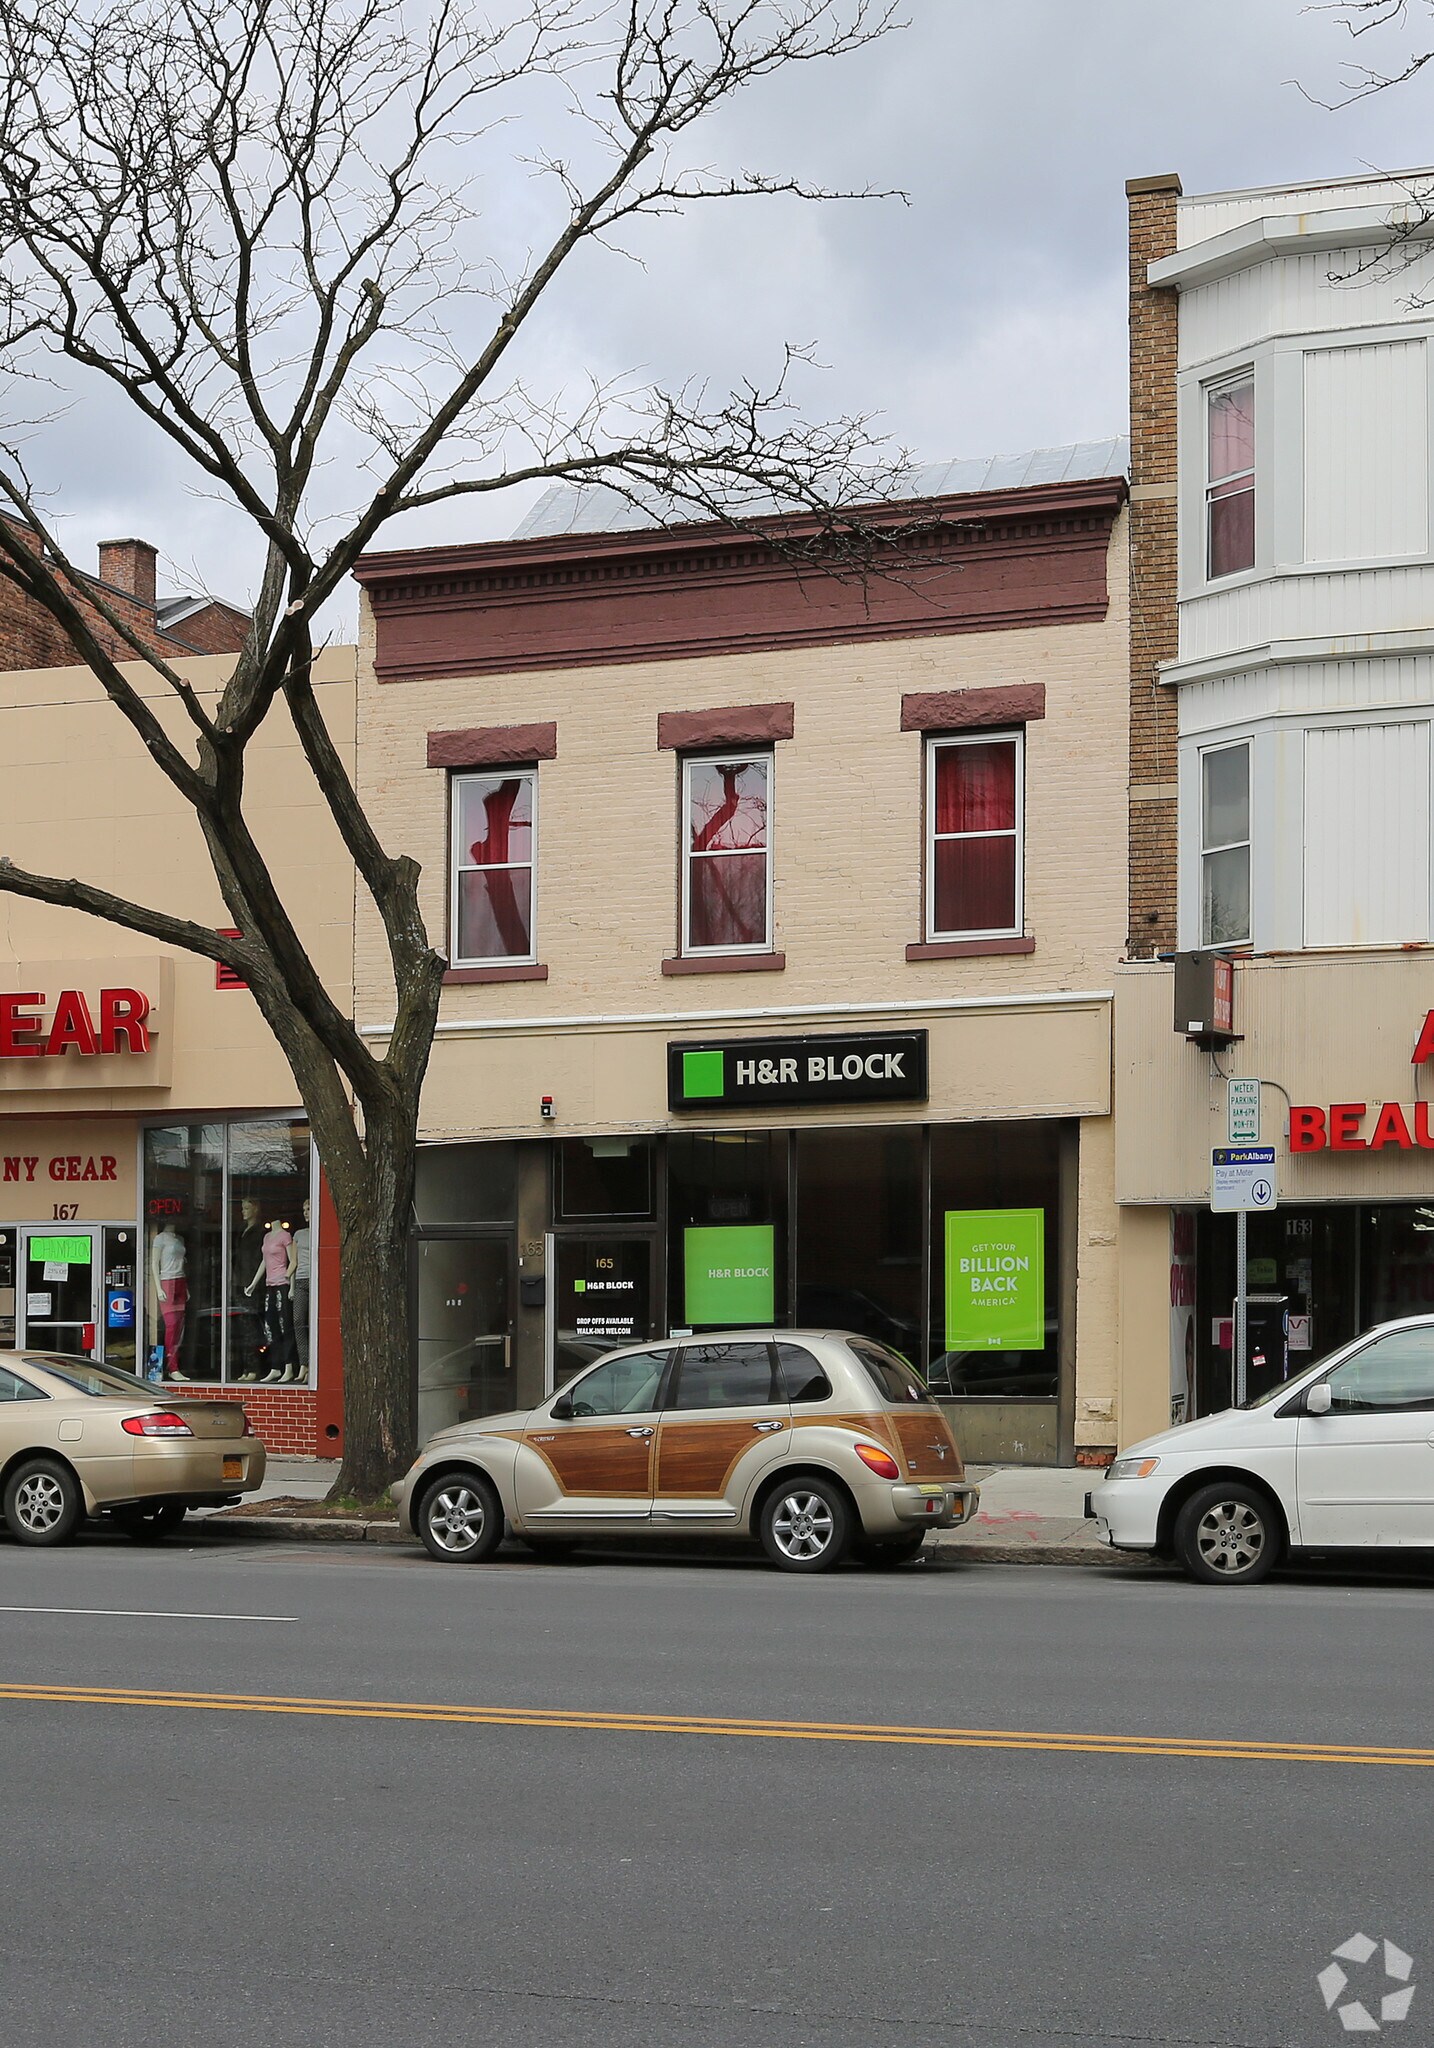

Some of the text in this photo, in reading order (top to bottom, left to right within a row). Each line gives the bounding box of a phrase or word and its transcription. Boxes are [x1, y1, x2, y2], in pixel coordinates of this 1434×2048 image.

[736, 1053, 906, 1085] H&R BLOCK
[1234, 1084, 1254, 1093] METER
[1230, 1096, 1257, 1105] PARKING
[1234, 1120, 1254, 1128] MON-FRI
[1231, 1152, 1273, 1161] ParkAlbany
[3, 1156, 117, 1182] NY GEAR
[53, 1204, 79, 1220] 167
[148, 1200, 182, 1214] OPEN
[1287, 1220, 1312, 1235] 163
[521, 1242, 543, 1257] 165
[972, 1243, 1016, 1252] GET YOUR
[596, 1258, 614, 1269] 165
[960, 1256, 1029, 1273] BILLION
[708, 1268, 770, 1279] H&R BLOCK
[587, 1281, 634, 1290] H&R BLOCK
[971, 1276, 1018, 1292] BACK
